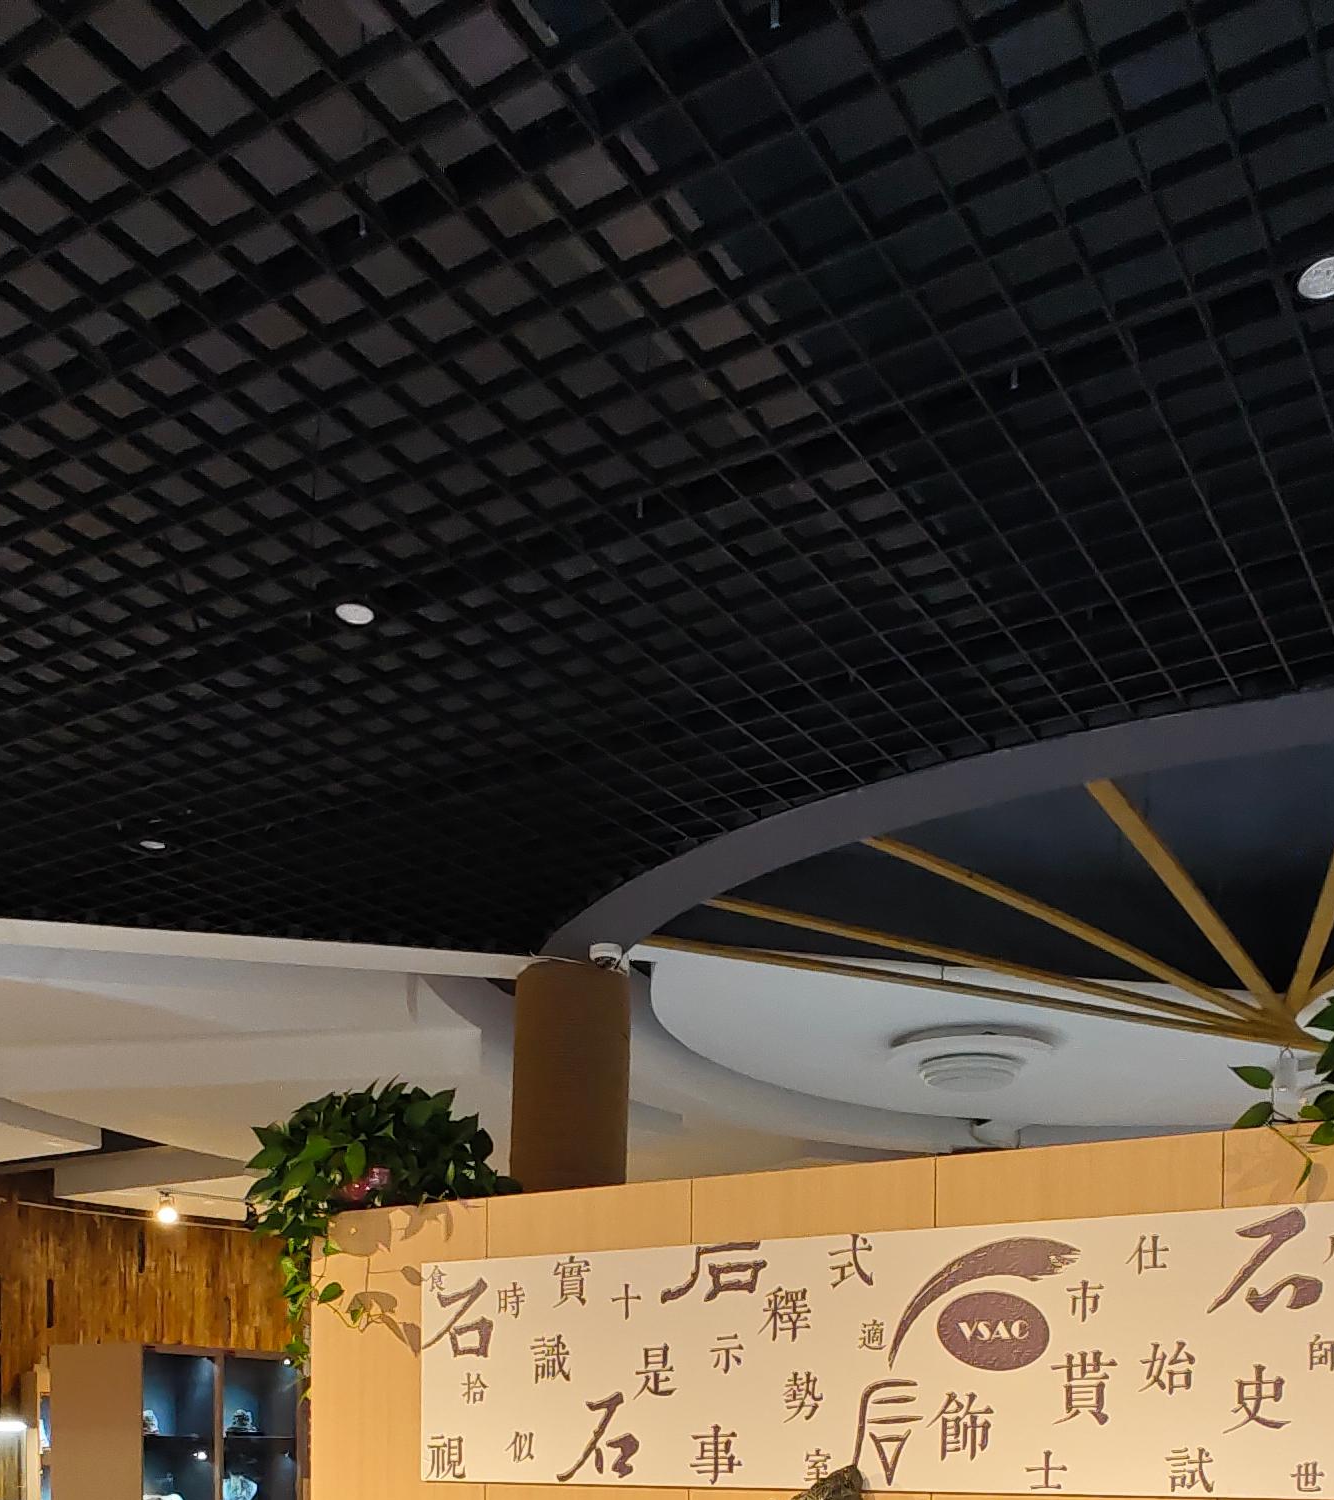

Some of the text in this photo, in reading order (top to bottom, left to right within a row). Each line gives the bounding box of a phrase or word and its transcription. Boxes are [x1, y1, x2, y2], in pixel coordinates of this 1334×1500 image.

[828, 1233, 874, 1288] 式
[1126, 1234, 1170, 1274] 仕
[498, 1282, 525, 1318] 時
[553, 1255, 590, 1306] 實
[611, 1284, 641, 1320] 十
[1066, 1280, 1104, 1322] 市
[422, 1277, 493, 1358] 石
[758, 1286, 811, 1342] 釋
[857, 1320, 886, 1350] 適
[957, 1319, 1030, 1341] VSAC
[531, 1334, 570, 1384] 識
[634, 1343, 676, 1399] 是
[710, 1334, 743, 1374] 示
[1139, 1341, 1195, 1395] 始
[461, 1373, 489, 1404] 拾
[783, 1371, 823, 1423] 勢
[1223, 1364, 1291, 1433] 史
[506, 1432, 534, 1462] 似
[556, 1391, 640, 1482] 石
[927, 1392, 994, 1461] 飾
[427, 1435, 466, 1479] 視
[689, 1424, 742, 1485] 事
[804, 1448, 832, 1484] 室
[1025, 1450, 1067, 1489] 士
[1165, 1447, 1214, 1493] 試
[1291, 1462, 1324, 1492] 世
